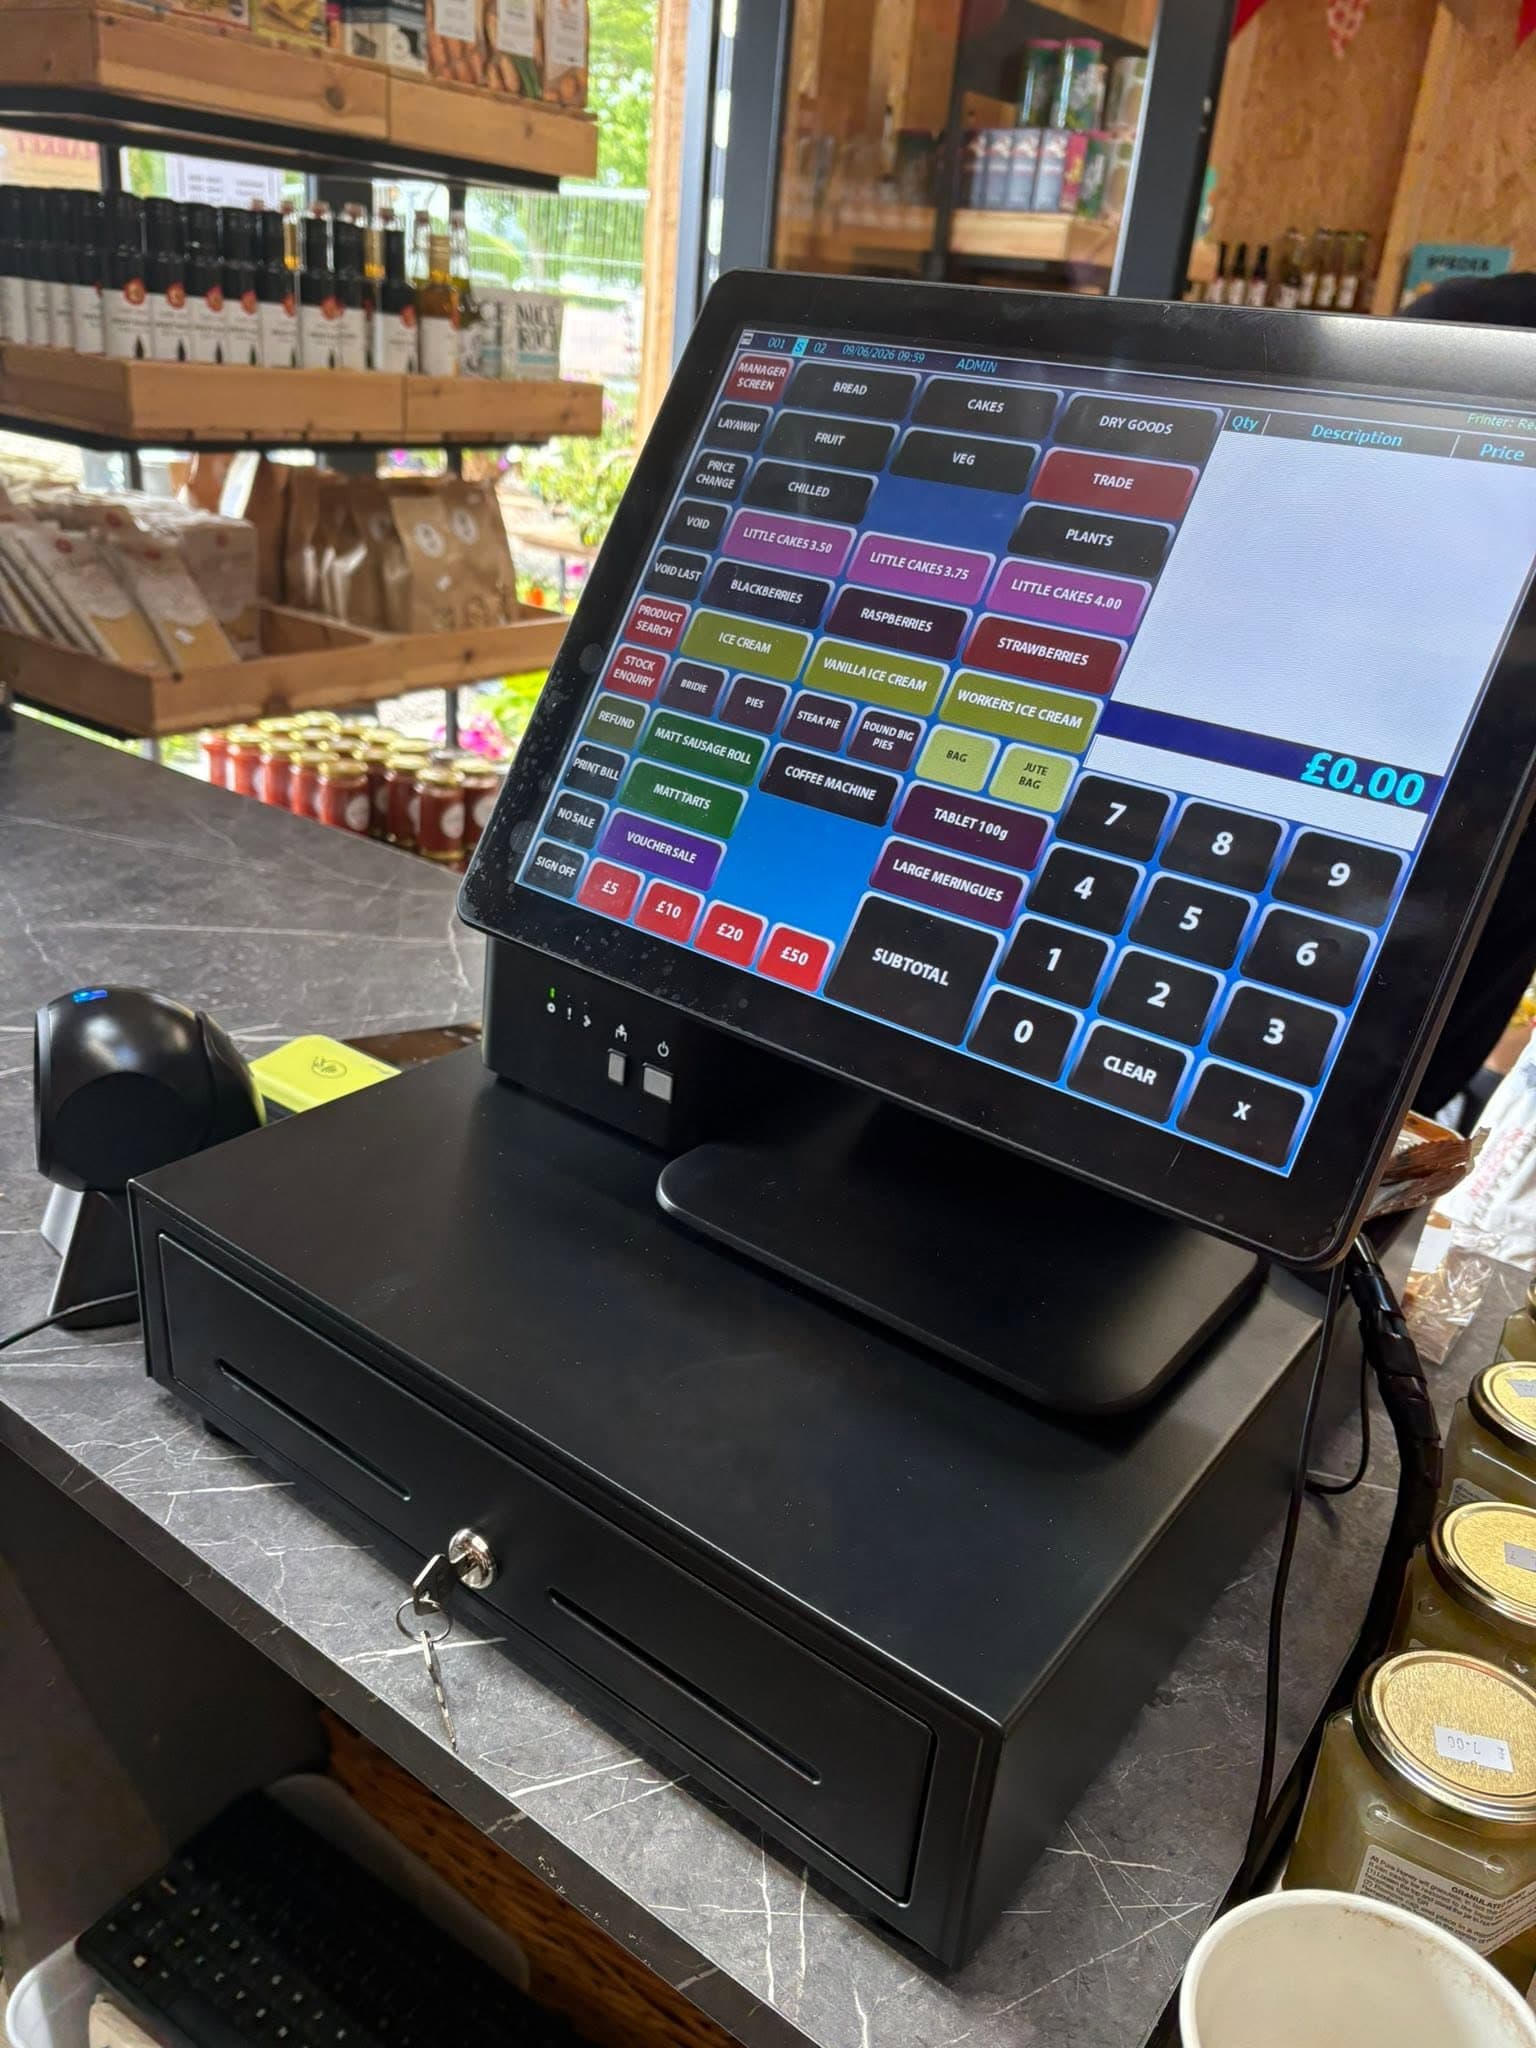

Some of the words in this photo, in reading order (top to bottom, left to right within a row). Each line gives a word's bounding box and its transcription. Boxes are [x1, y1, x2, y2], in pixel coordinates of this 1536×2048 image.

[768, 337, 785, 349] 001
[813, 342, 827, 354] 02
[842, 344, 895, 361] 09/06/2026
[897, 349, 925, 363] 09:59
[956, 358, 998, 373] ADMIN
[738, 362, 787, 377] MANAGER
[736, 377, 774, 391] SCREEN
[833, 381, 868, 396] BREAD
[967, 399, 1004, 413] CAKES
[718, 418, 760, 433] LAYAWAY
[1099, 415, 1126, 429] DRY
[1127, 419, 1174, 435] GOODS
[1467, 412, 1514, 427] Printer:
[815, 432, 846, 446] FRUIT
[1231, 415, 1259, 432] Qty
[1311, 424, 1403, 448] Description
[1480, 443, 1525, 461] Price
[707, 460, 735, 474] PRICE
[952, 452, 975, 465] VEG
[695, 473, 735, 489] CHANGE
[788, 481, 830, 498] CHILLED
[1093, 473, 1135, 489] TRADE
[686, 515, 710, 529] VOID
[743, 527, 776, 544] LITTLE
[776, 534, 809, 550] CAKES
[809, 540, 833, 554] 3.50
[1065, 528, 1114, 546] PLANTS
[654, 562, 677, 576] VOID
[677, 567, 702, 582] LAST
[869, 552, 905, 569] LITTLE
[906, 559, 943, 577] CAKES
[943, 565, 970, 580] 3.75
[730, 579, 803, 604] BLACKBERRIES
[1011, 578, 1050, 597] LITTLE
[1052, 587, 1093, 605] CAKES
[1094, 595, 1122, 610] 4.00
[638, 604, 682, 624] PRODUCT
[860, 607, 933, 633] RASPBERRIES
[635, 620, 673, 638] SEARCH
[718, 631, 736, 645] ICE
[736, 636, 772, 654] CREAM
[997, 637, 1089, 666] STRAWBERRIES
[623, 654, 656, 672] STOCK
[613, 669, 655, 688] ENQUIRY
[823, 657, 867, 677] VANILLA
[867, 668, 886, 682] ICE
[887, 674, 928, 692] CREAM
[680, 679, 708, 694] BRIDIE
[745, 695, 765, 709] PIES
[957, 688, 1014, 713] WORKERS
[1014, 702, 1036, 718] ICE
[1037, 708, 1082, 730] CREAM
[597, 710, 635, 729] REFUND
[797, 709, 825, 726] STEAK
[824, 717, 841, 730] PIE
[862, 720, 896, 738] ROUND
[896, 728, 915, 742] BIG
[655, 726, 682, 744] MATT
[682, 735, 728, 759] SAUSAGE
[726, 748, 752, 766] ROLL
[872, 738, 894, 752] PIES
[946, 749, 968, 764] BAG
[573, 757, 600, 775] PRINT
[599, 765, 620, 782] BILL
[1023, 761, 1049, 777] JUTE
[1300, 752, 1425, 806] £0.00
[784, 765, 825, 785] COFFEE
[823, 775, 877, 801] MACHINE
[1018, 775, 1041, 790] BAG
[653, 783, 681, 801] MATT
[680, 791, 712, 810] TARTS
[557, 807, 572, 822] NO
[571, 812, 596, 829] SALE
[933, 807, 977, 831] TABLET
[977, 819, 1009, 842] 100g
[1104, 801, 1127, 827] 7
[627, 831, 673, 856] VOUCHER
[671, 847, 697, 864] SALE
[1210, 831, 1234, 856] 8
[535, 855, 558, 871] SIGN
[555, 862, 577, 879] OFF
[1327, 862, 1351, 887] 9
[601, 880, 619, 895] £5
[893, 858, 931, 880] LARGE
[930, 870, 1004, 902] MERINGUES
[1074, 876, 1096, 900] 4
[655, 900, 682, 919] £10
[1178, 906, 1203, 931] 5
[716, 923, 744, 942] £20
[780, 946, 810, 966] £50
[1047, 948, 1062, 971] 1
[1295, 942, 1319, 966] 6
[872, 947, 950, 987] SUBTOTAL
[1146, 982, 1171, 1008] 2
[1013, 1019, 1034, 1043] 0
[1262, 1018, 1286, 1044] 3
[1103, 1055, 1157, 1086] CLEAR
